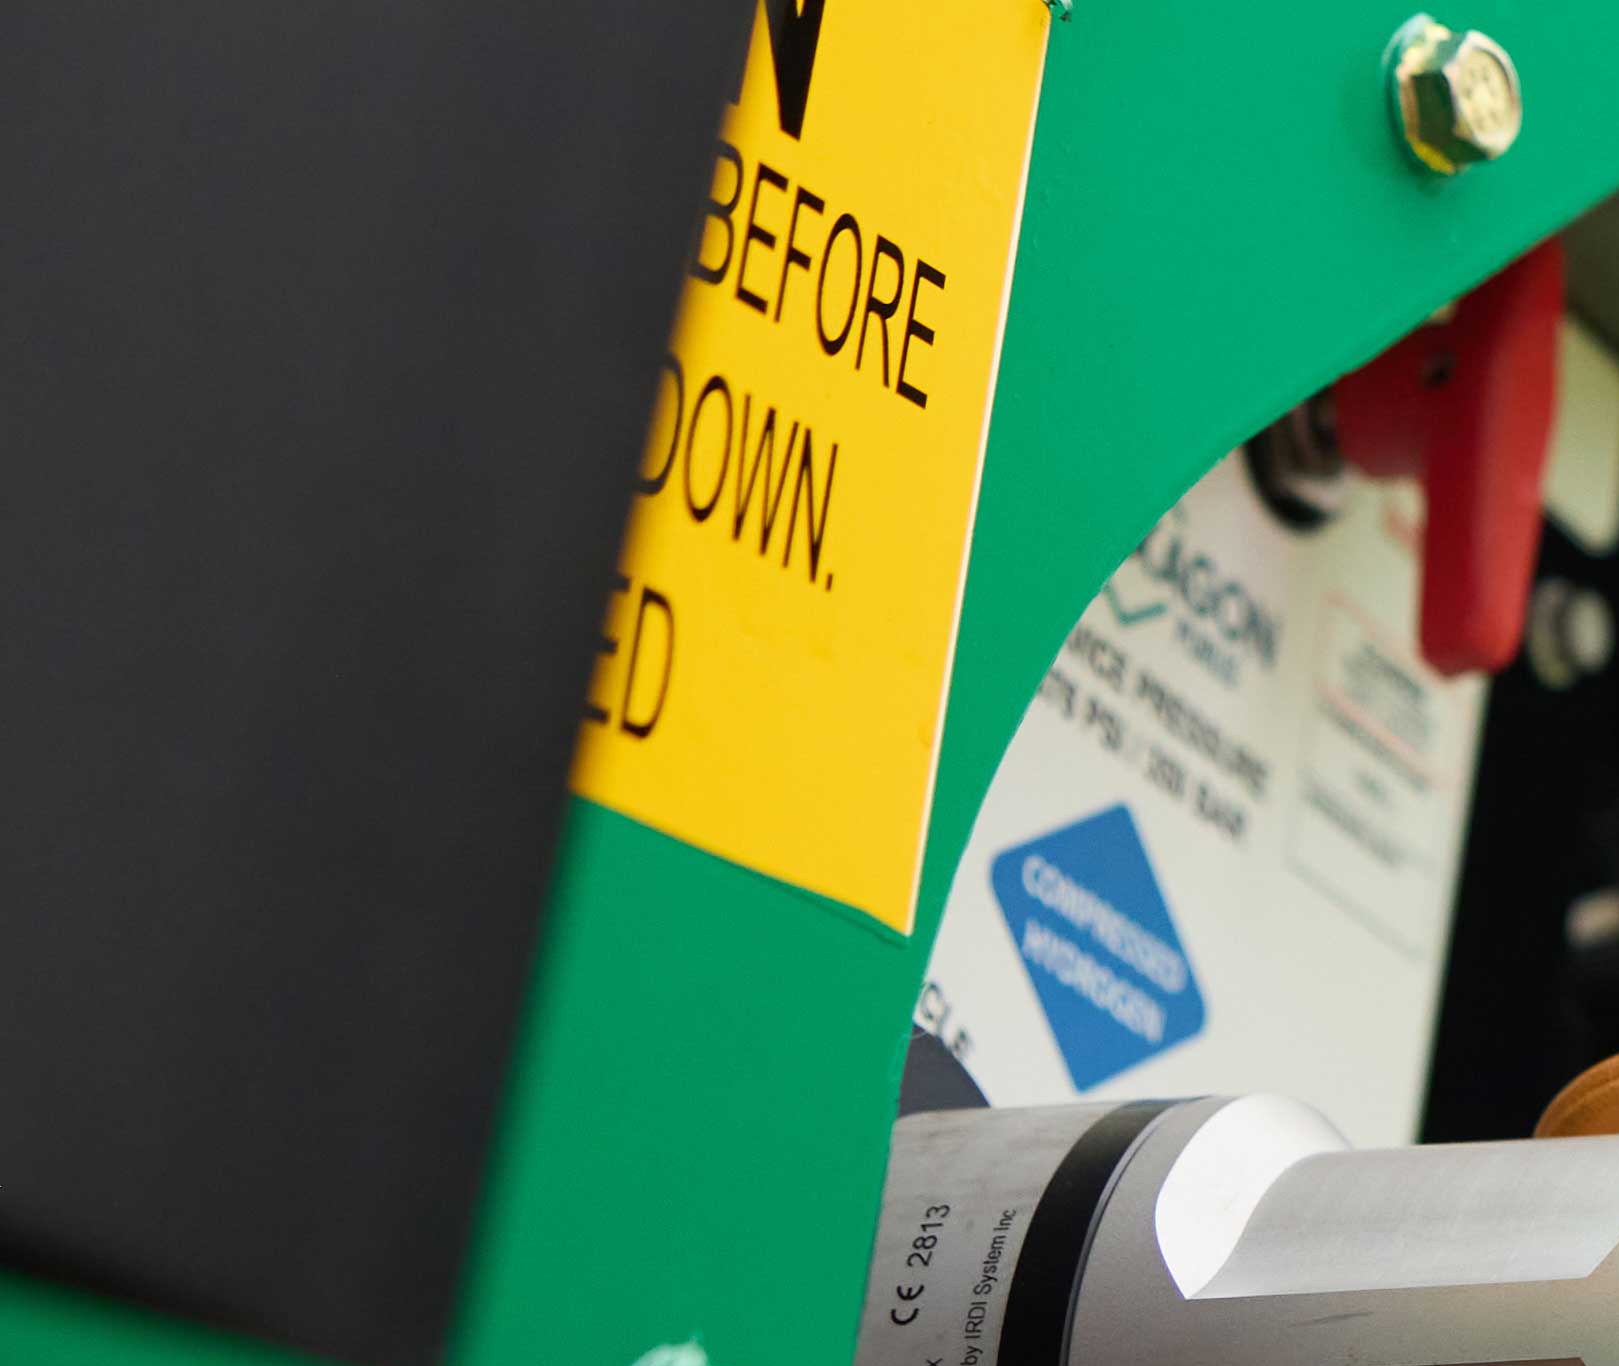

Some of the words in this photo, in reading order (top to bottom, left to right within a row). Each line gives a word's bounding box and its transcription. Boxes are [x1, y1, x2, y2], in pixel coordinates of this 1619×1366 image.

[690, 140, 946, 411] BEFORE
[1021, 853, 1188, 995] COMPRESSED
[1021, 918, 1167, 1043] HYDROGEN
[906, 1204, 951, 1267] 2813
[993, 1208, 1017, 1232] Inc
[972, 1235, 1007, 1296] System
[890, 1283, 925, 1326] CE
[965, 1301, 988, 1339] IRDI
[960, 1345, 984, 1366] by
